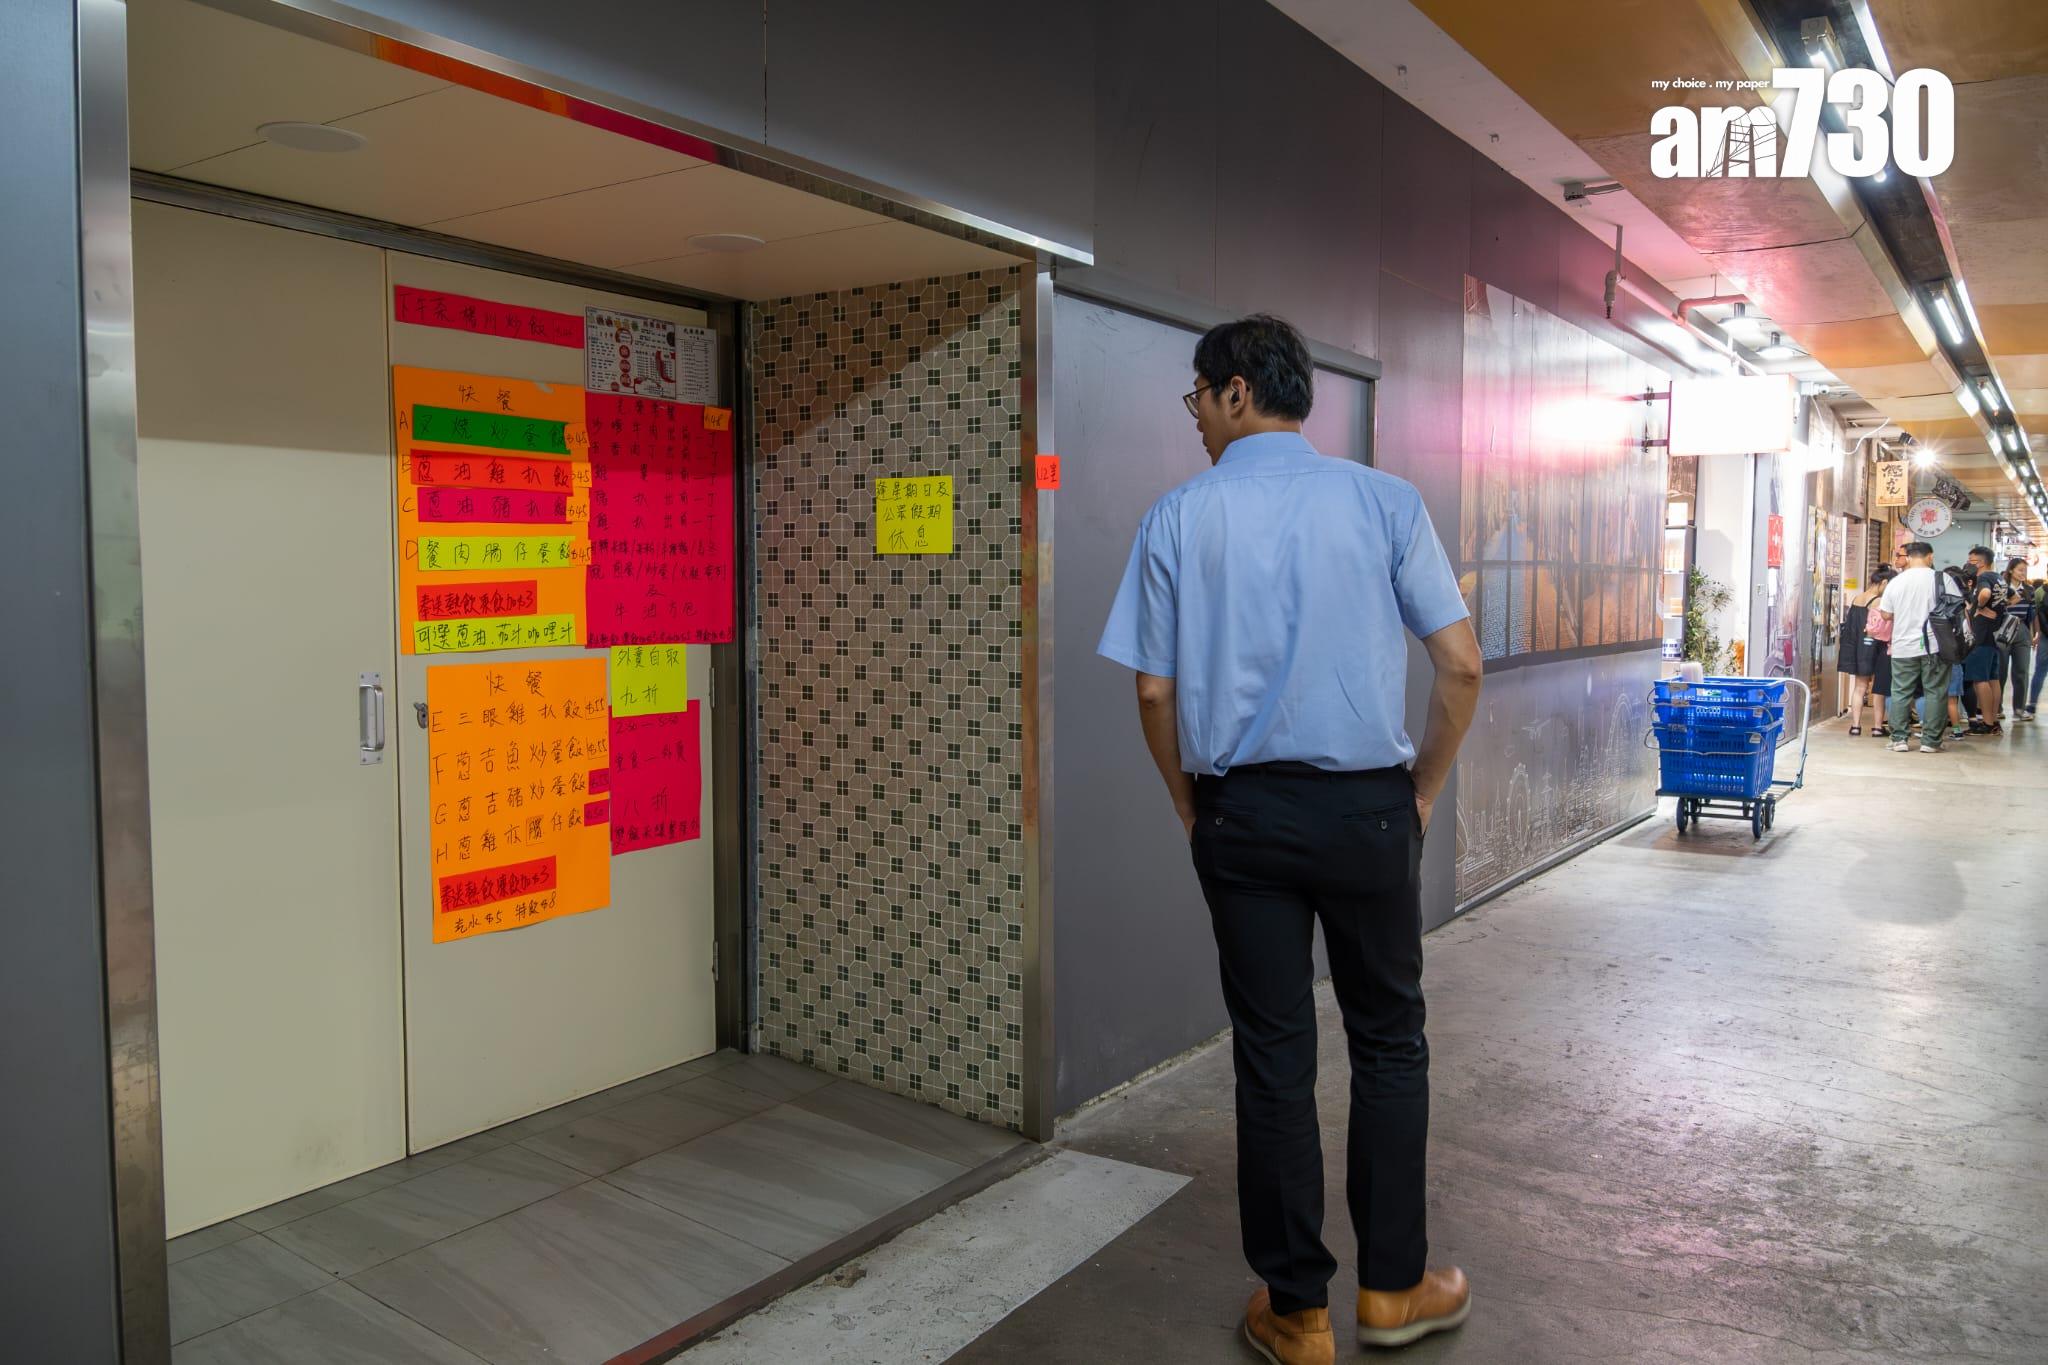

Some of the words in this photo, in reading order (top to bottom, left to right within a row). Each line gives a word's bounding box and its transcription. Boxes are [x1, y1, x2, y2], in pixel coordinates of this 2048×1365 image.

[458, 384, 514, 412] 快餐
[399, 411, 409, 431] A
[401, 455, 412, 473] B
[876, 480, 950, 501] 逢星期日及
[402, 497, 416, 513] C
[883, 503, 942, 522] 公眾假期
[888, 525, 929, 551] 休息
[405, 540, 418, 561] D
[616, 646, 681, 669] 外賣自取
[486, 670, 545, 698] 快餐
[620, 683, 658, 705] 九折
[432, 710, 446, 733] E
[432, 752, 448, 785] F
[434, 802, 449, 825] G
[436, 842, 449, 864] H
